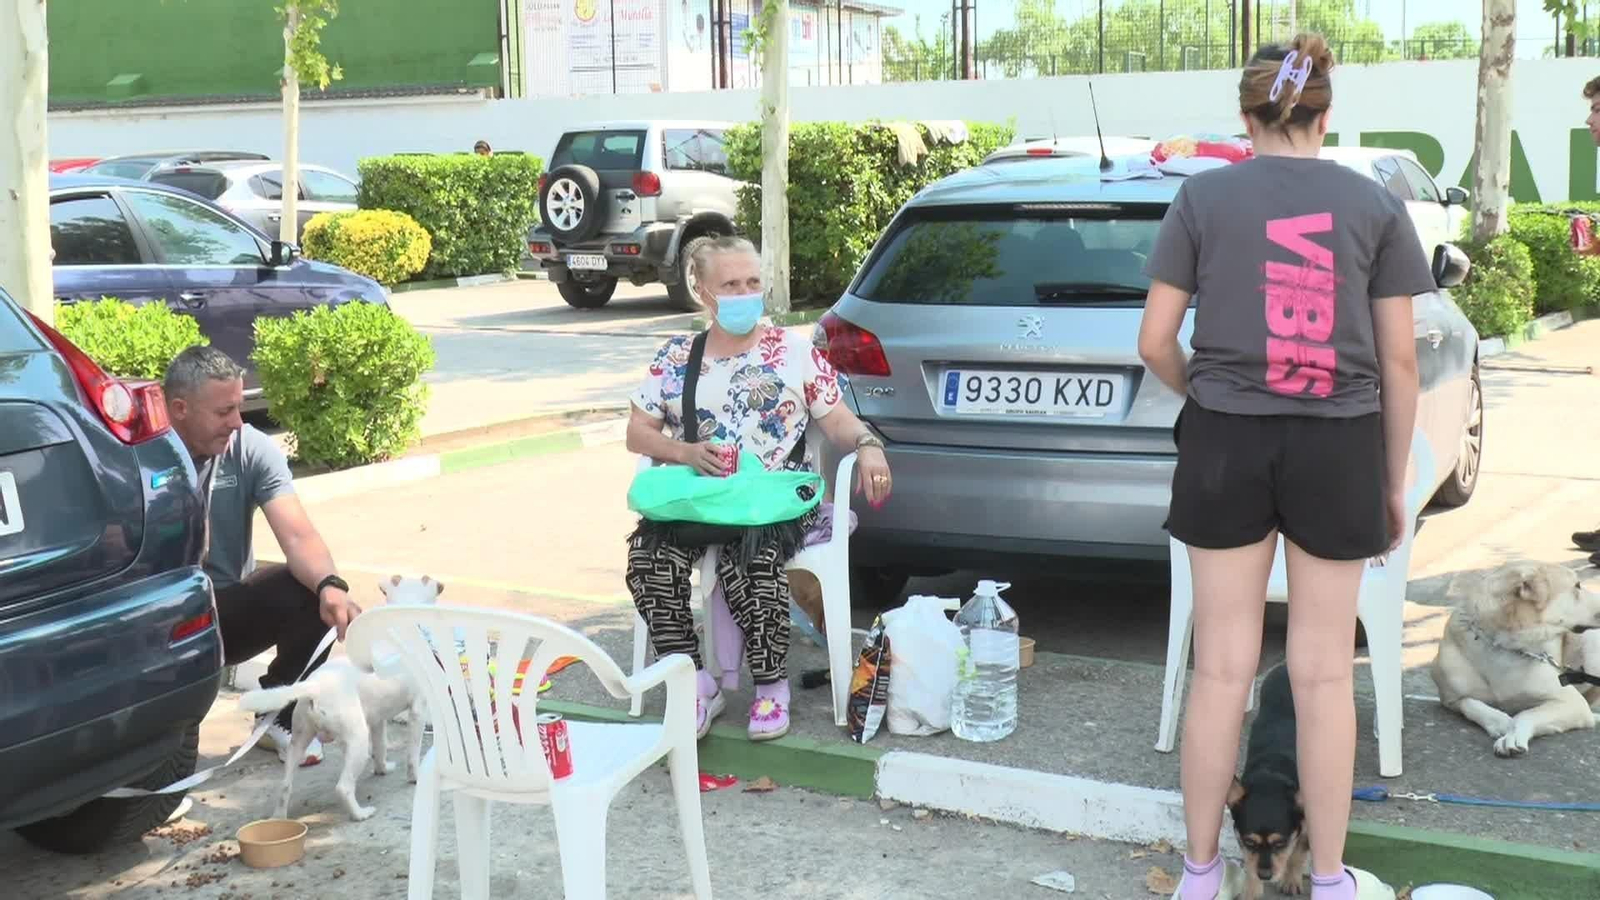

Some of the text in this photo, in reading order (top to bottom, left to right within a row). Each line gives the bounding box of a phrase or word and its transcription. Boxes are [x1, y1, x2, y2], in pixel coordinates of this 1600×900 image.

[1265, 212, 1336, 398] VIBES
[965, 375, 1114, 407] 9330 KXD
